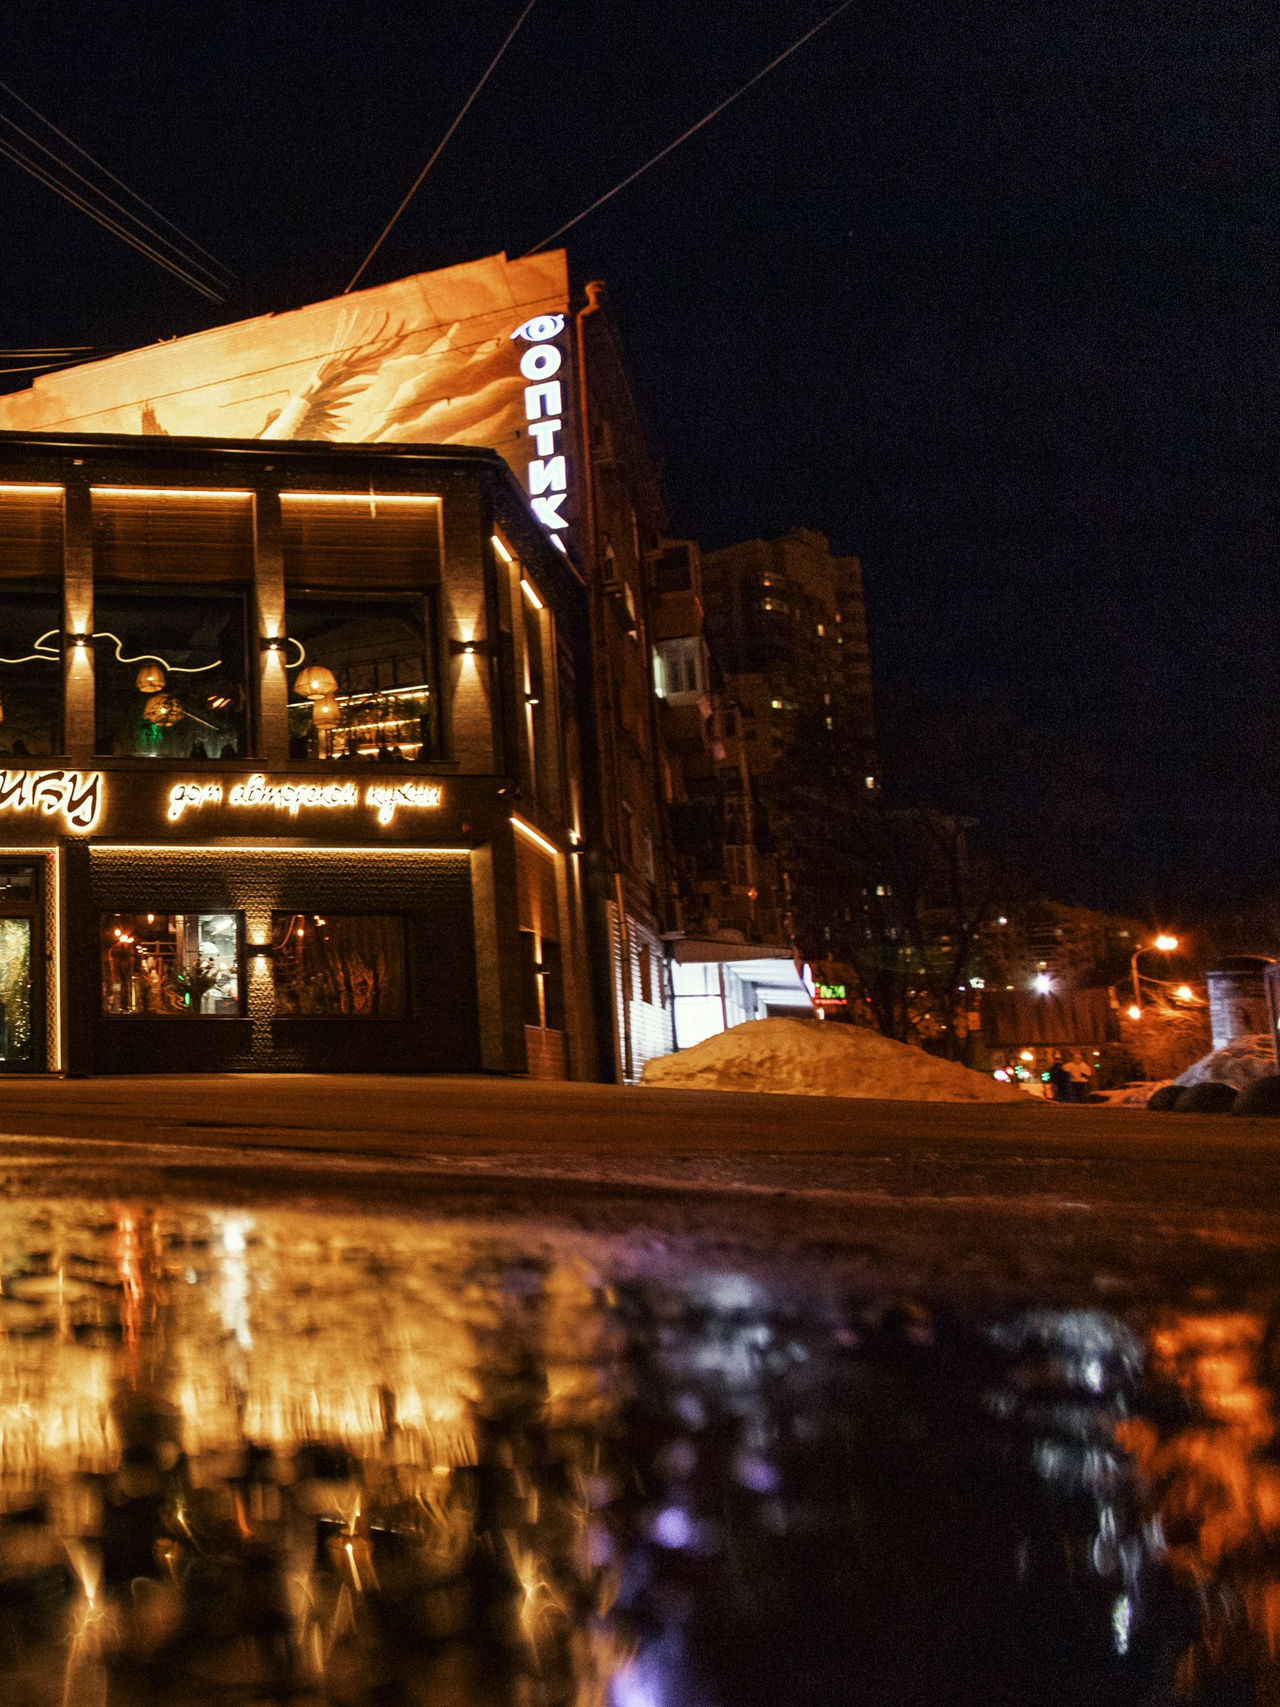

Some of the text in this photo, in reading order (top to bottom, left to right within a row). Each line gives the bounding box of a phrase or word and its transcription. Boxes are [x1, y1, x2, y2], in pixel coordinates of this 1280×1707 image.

[520, 344, 568, 553] ОПТИК
[167, 773, 440, 825] дом авторской кухни
